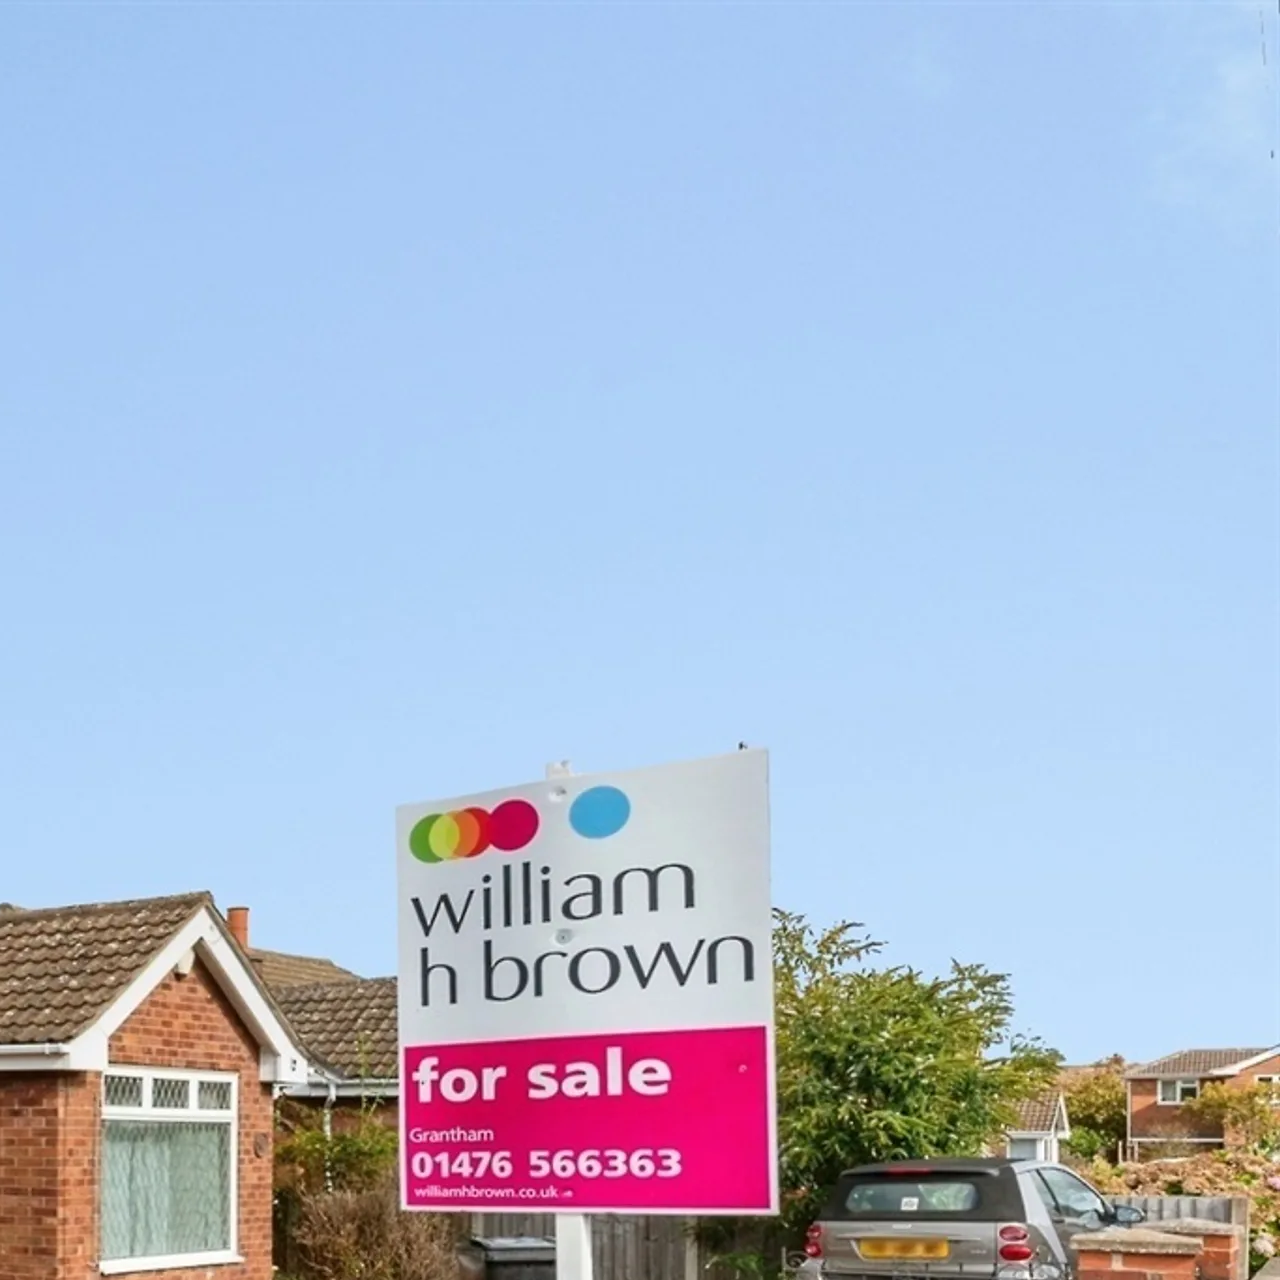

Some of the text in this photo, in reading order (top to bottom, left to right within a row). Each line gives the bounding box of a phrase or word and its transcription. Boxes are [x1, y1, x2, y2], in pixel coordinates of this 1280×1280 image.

[410, 861, 696, 937] william
[420, 935, 755, 1007] h brown
[411, 1046, 672, 1104] for sale
[409, 1126, 495, 1143] Grantham
[411, 1148, 683, 1179] 01476 566363
[414, 1185, 559, 1199] williamhbrown.co.uk
